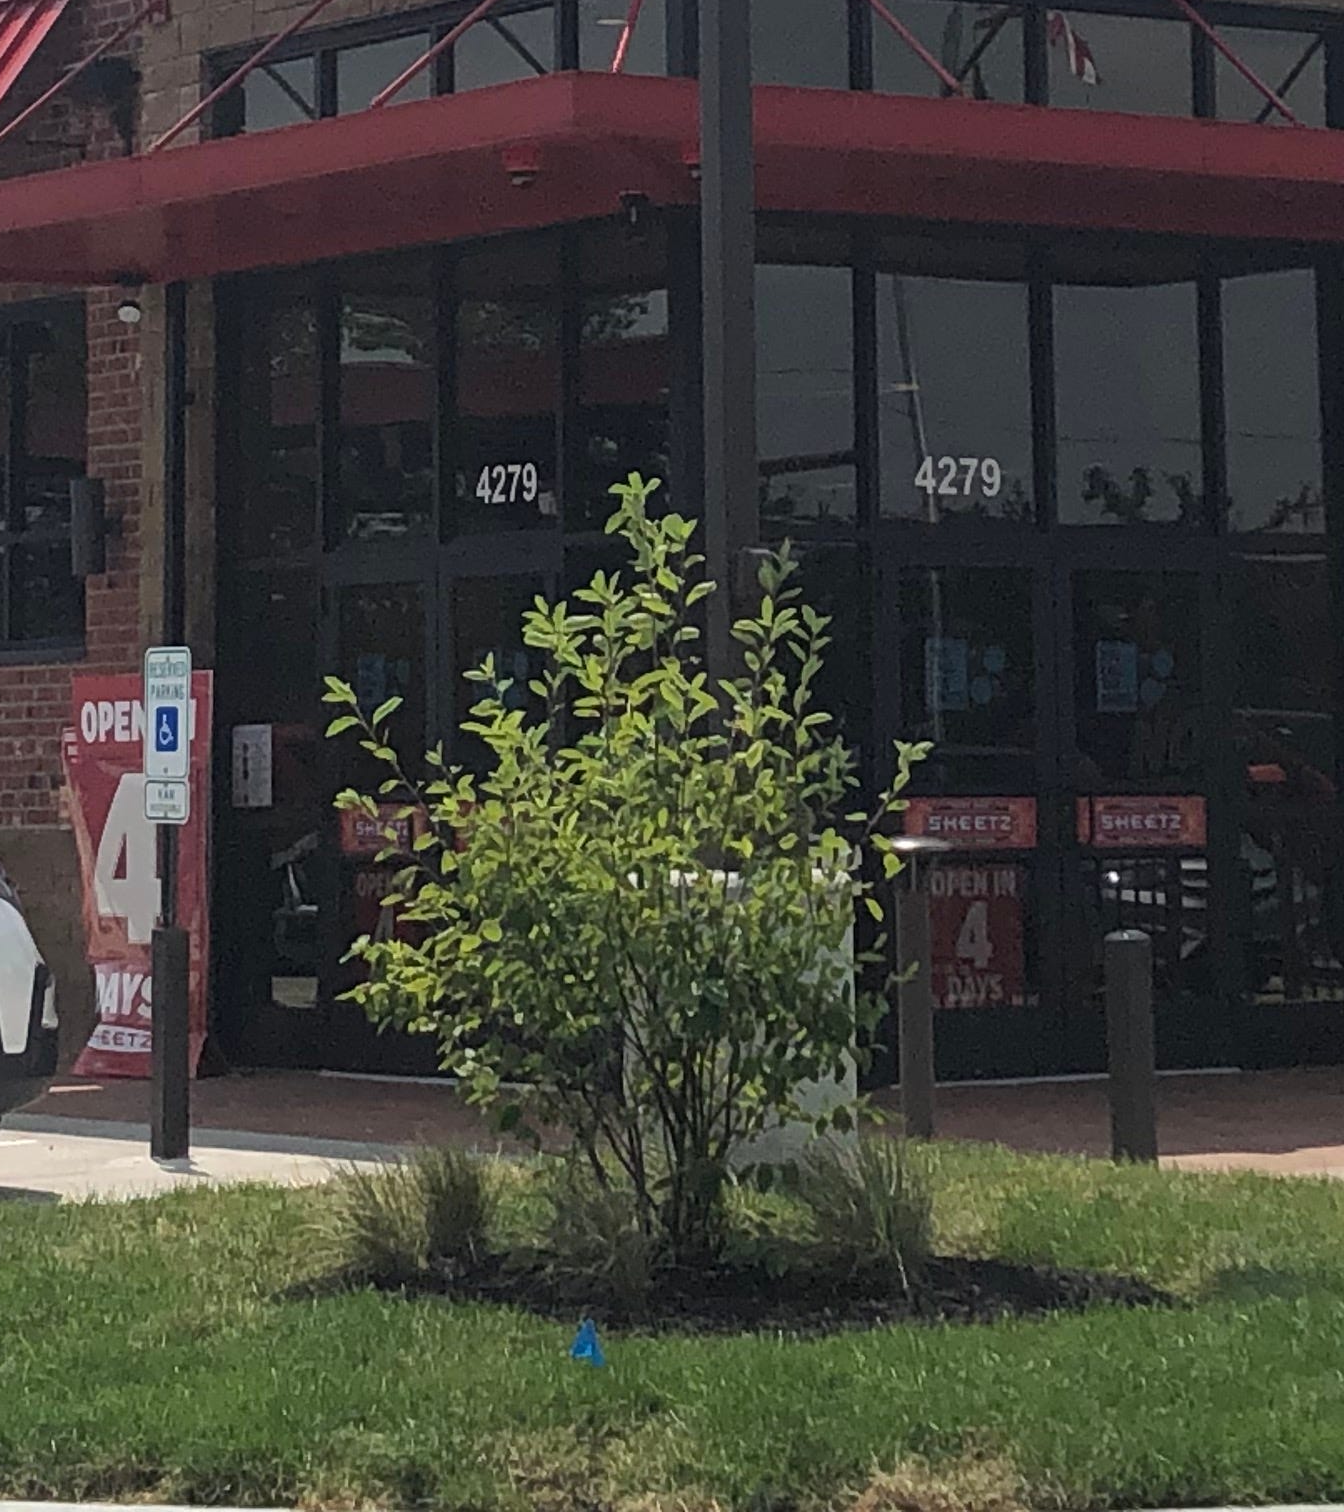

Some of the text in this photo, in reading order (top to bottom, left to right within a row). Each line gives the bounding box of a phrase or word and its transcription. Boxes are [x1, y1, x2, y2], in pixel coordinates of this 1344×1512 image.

[475, 463, 538, 504] 4279
[914, 456, 1001, 497] 4279
[81, 700, 146, 743] OPEN
[928, 815, 1012, 831] SHEETZ
[1101, 814, 1181, 829] SHEETZ
[94, 772, 162, 944] 4
[957, 900, 994, 967] 4
